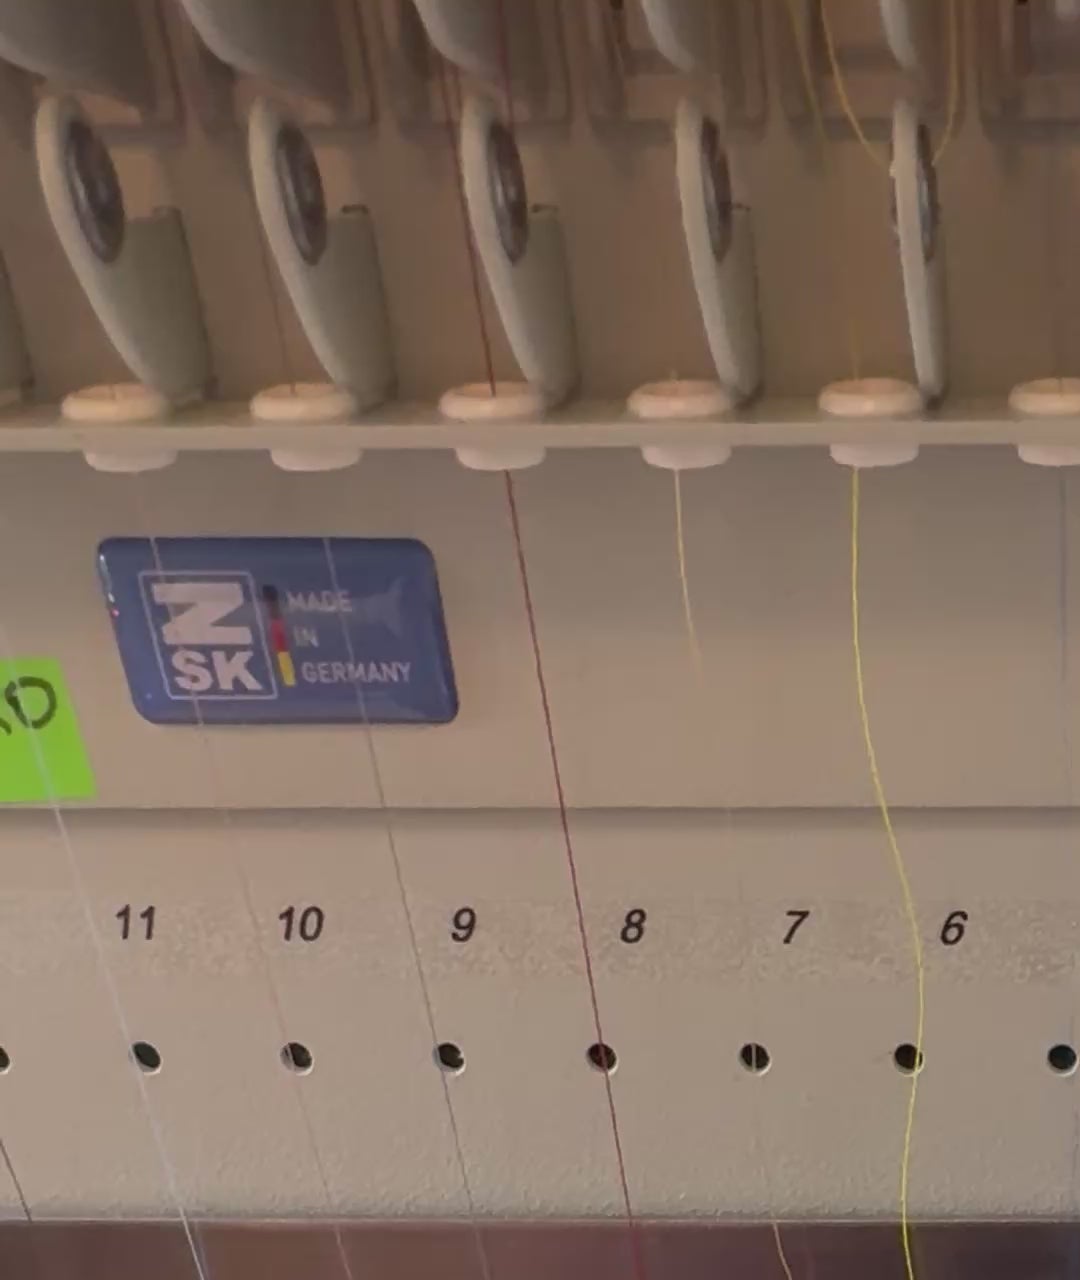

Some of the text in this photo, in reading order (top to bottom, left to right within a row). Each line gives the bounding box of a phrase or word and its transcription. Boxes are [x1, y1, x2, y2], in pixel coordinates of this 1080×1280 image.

[151, 582, 252, 645] Z
[286, 589, 352, 612] MADE
[293, 626, 319, 648] IN
[170, 649, 264, 691] SK
[301, 660, 412, 684] GERMANY
[114, 904, 156, 941] 11
[278, 905, 325, 942] 10
[451, 906, 477, 943] 9
[620, 908, 647, 944] 8
[783, 909, 811, 945] 7
[939, 910, 969, 946] 6
